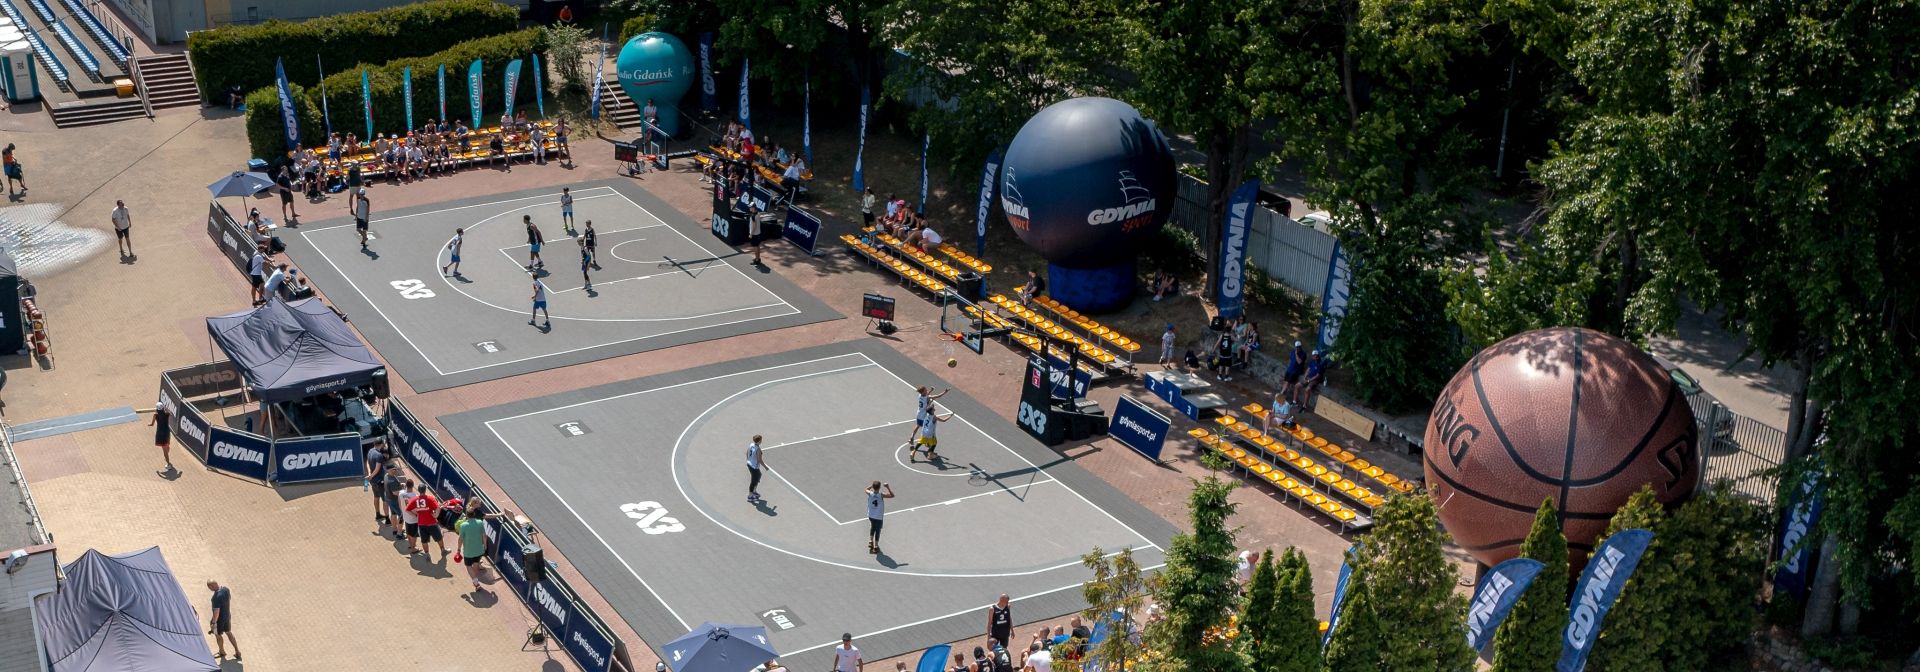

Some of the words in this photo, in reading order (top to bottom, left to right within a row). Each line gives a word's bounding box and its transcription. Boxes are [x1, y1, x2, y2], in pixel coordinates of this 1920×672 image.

[633, 67, 673, 80] Gdańsk
[978, 163, 998, 236] GDYNIA
[1087, 199, 1156, 226] GDYNIA
[1223, 202, 1249, 298] GDYNIA
[305, 378, 347, 393] gdyniasport.pl
[1150, 379, 1155, 390] 2
[1168, 390, 1173, 402] 1
[1186, 405, 1192, 415] 3
[180, 415, 205, 445] GDYNIA
[1119, 415, 1157, 441] gdyniasport.pl
[213, 441, 265, 466] GDYNIA
[282, 449, 353, 471] GDYNIA
[411, 441, 438, 476] GDYNIA
[415, 498, 427, 508] 13
[533, 582, 566, 625] GDYNIA
[1567, 545, 1625, 650] GDYNIA
[573, 631, 605, 667] gdyniasport.pl
